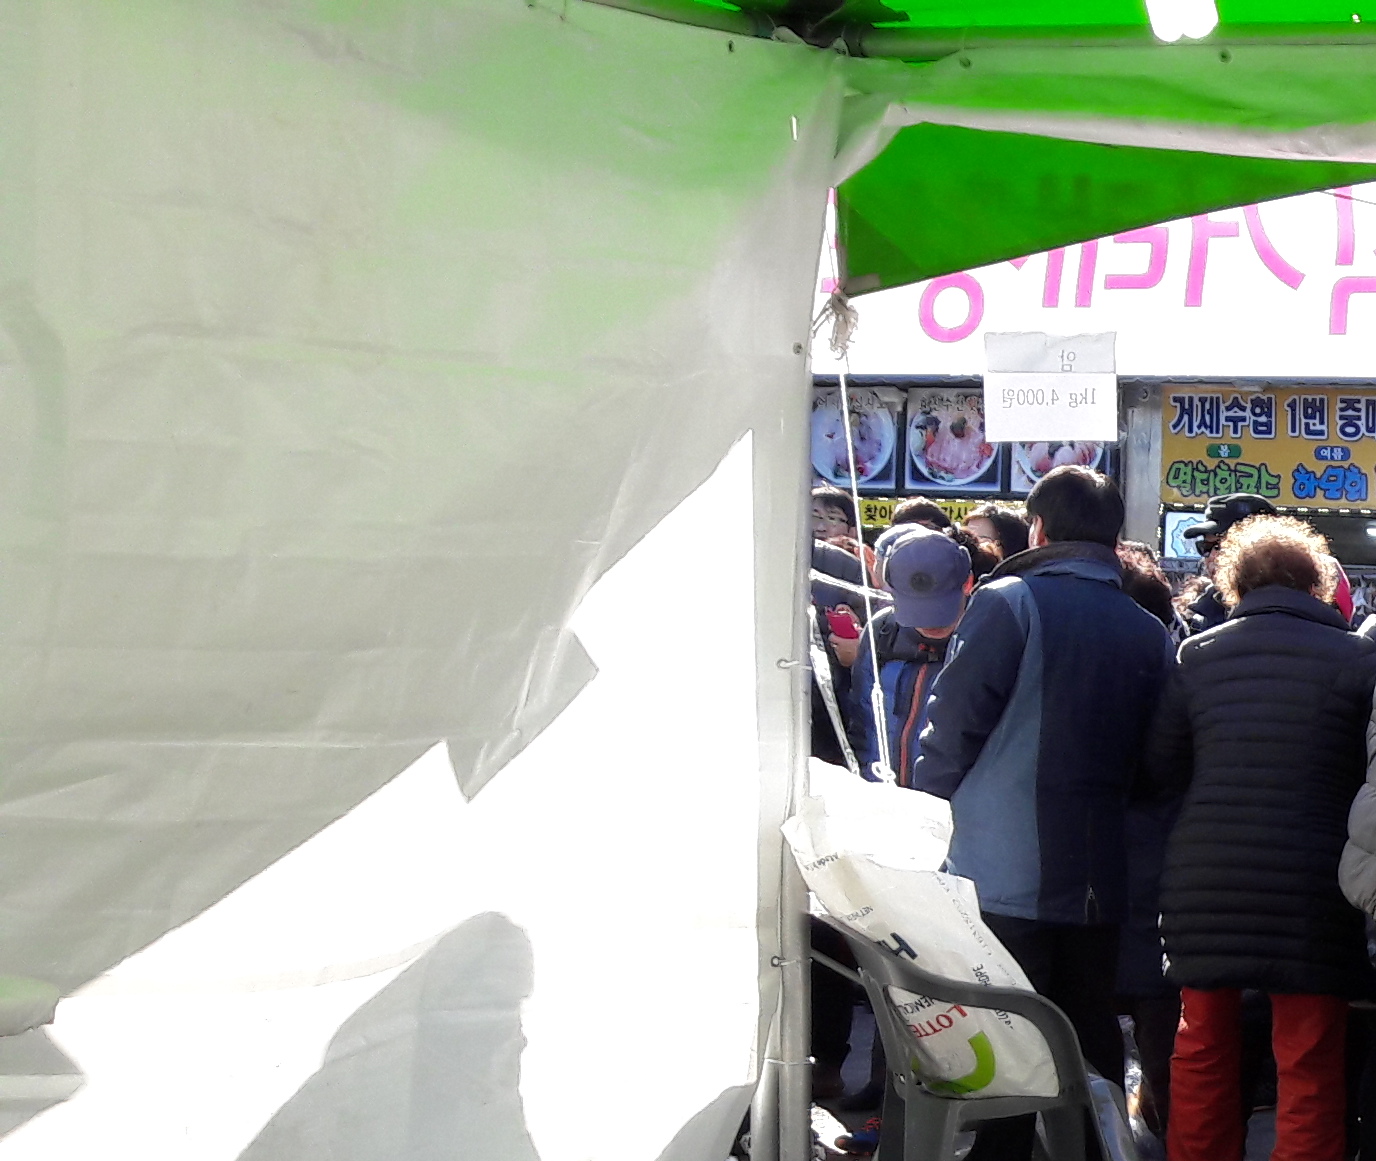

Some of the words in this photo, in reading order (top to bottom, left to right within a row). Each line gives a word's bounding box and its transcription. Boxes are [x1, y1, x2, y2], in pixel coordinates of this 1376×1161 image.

[1169, 393, 1276, 439] 거제수협
[1284, 395, 1328, 439] 1번
[1320, 446, 1344, 460] 여름
[1291, 462, 1369, 502] 하모회
[906, 1004, 968, 1039] LOTTE
